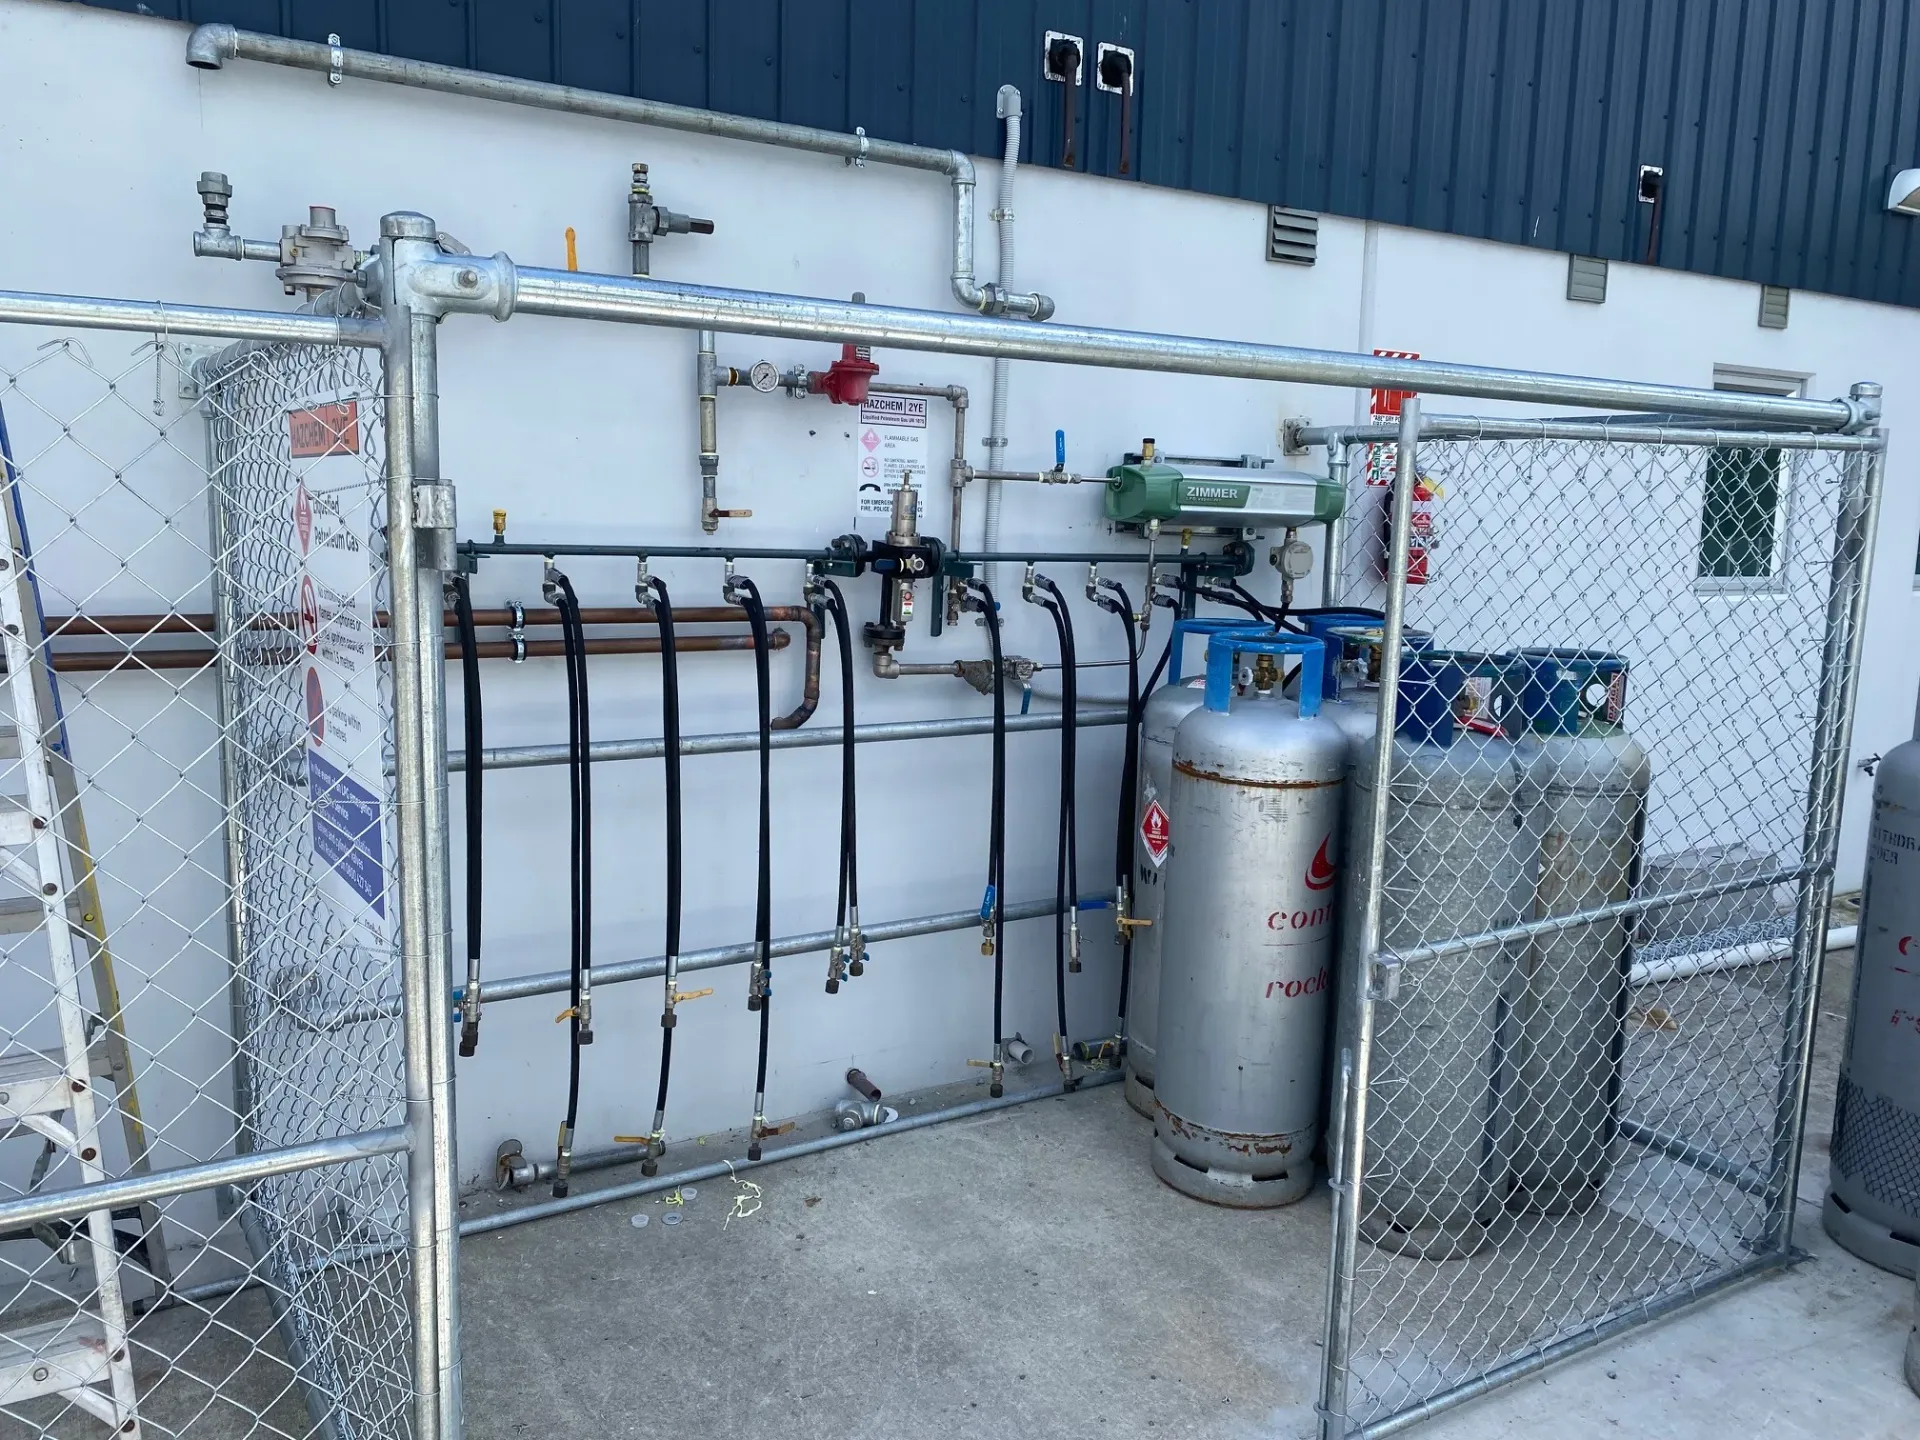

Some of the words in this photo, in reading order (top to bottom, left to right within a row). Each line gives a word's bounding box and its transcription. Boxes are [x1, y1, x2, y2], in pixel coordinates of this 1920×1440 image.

[863, 399, 903, 411] HAZCHEM
[908, 402, 924, 413] 2YE
[292, 420, 326, 448] HAZCHEM
[332, 416, 350, 445] 2YE
[1186, 486, 1238, 499] ZIMMER
[312, 495, 340, 519] Liquefied
[314, 526, 346, 551] Petroleum
[346, 530, 359, 552] Gas
